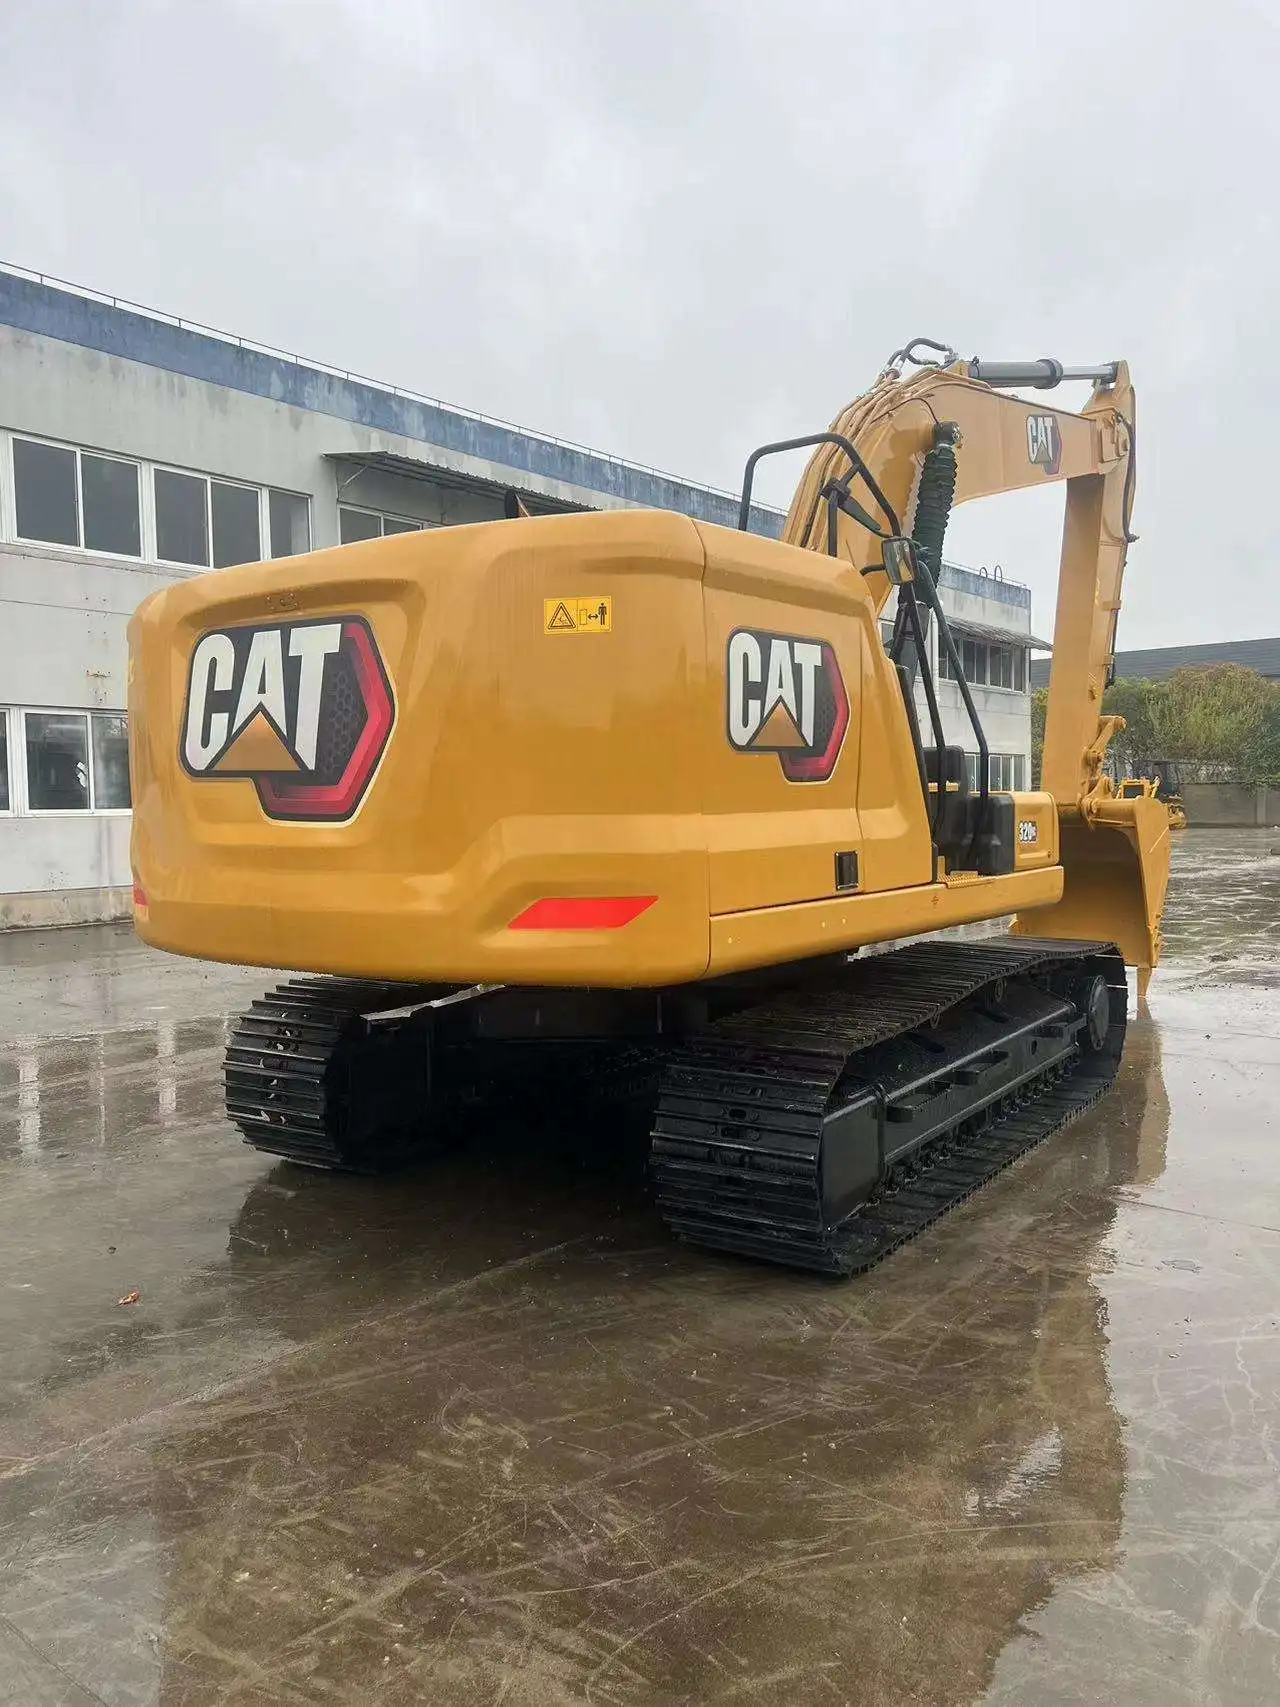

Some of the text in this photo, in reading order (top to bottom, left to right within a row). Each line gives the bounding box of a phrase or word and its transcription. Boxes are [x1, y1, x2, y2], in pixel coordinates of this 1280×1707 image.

[1026, 415, 1053, 462] CAT
[185, 623, 342, 771] CAT
[729, 632, 822, 747] CAT
